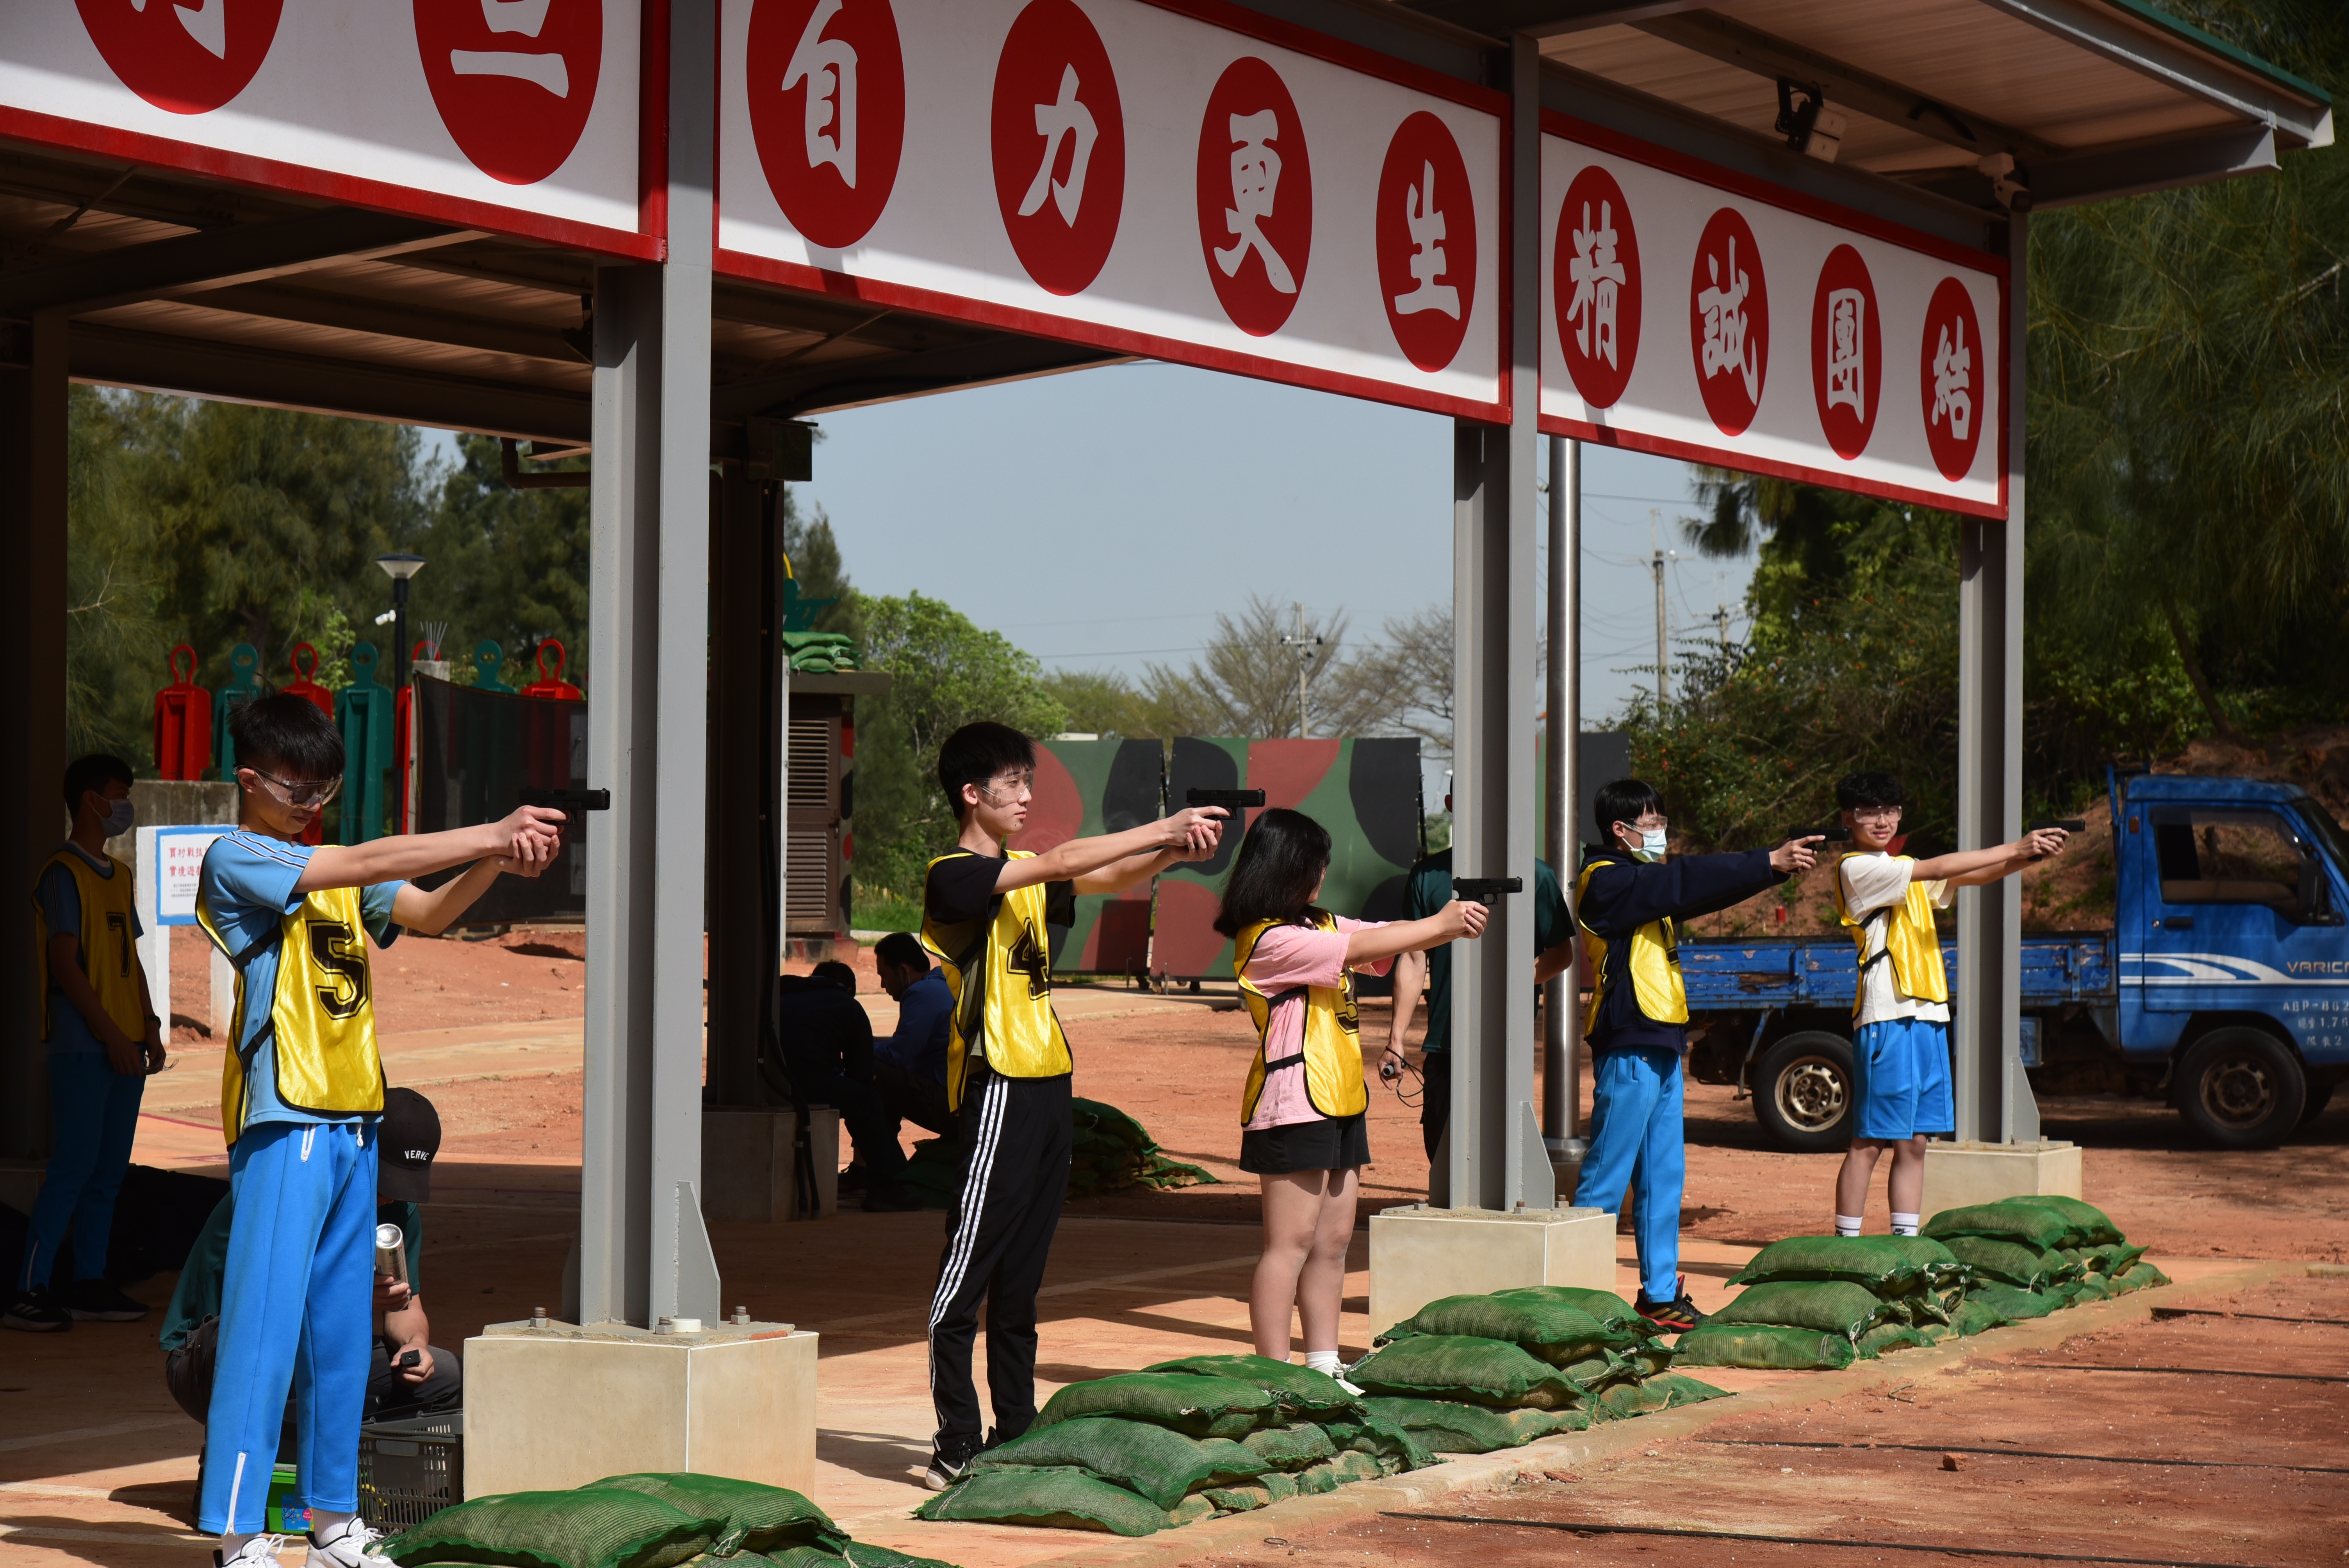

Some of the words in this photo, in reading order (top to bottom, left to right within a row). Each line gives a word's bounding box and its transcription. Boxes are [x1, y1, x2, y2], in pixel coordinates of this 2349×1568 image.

[782, 0, 1460, 320] 自力更生
[1567, 199, 1971, 440] 精誠團結
[169, 847, 208, 858] 賈村戰技
[106, 912, 130, 978] 7
[307, 919, 369, 1020] 5
[1006, 916, 1051, 1001] 4
[405, 1150, 429, 1161] VERVE
